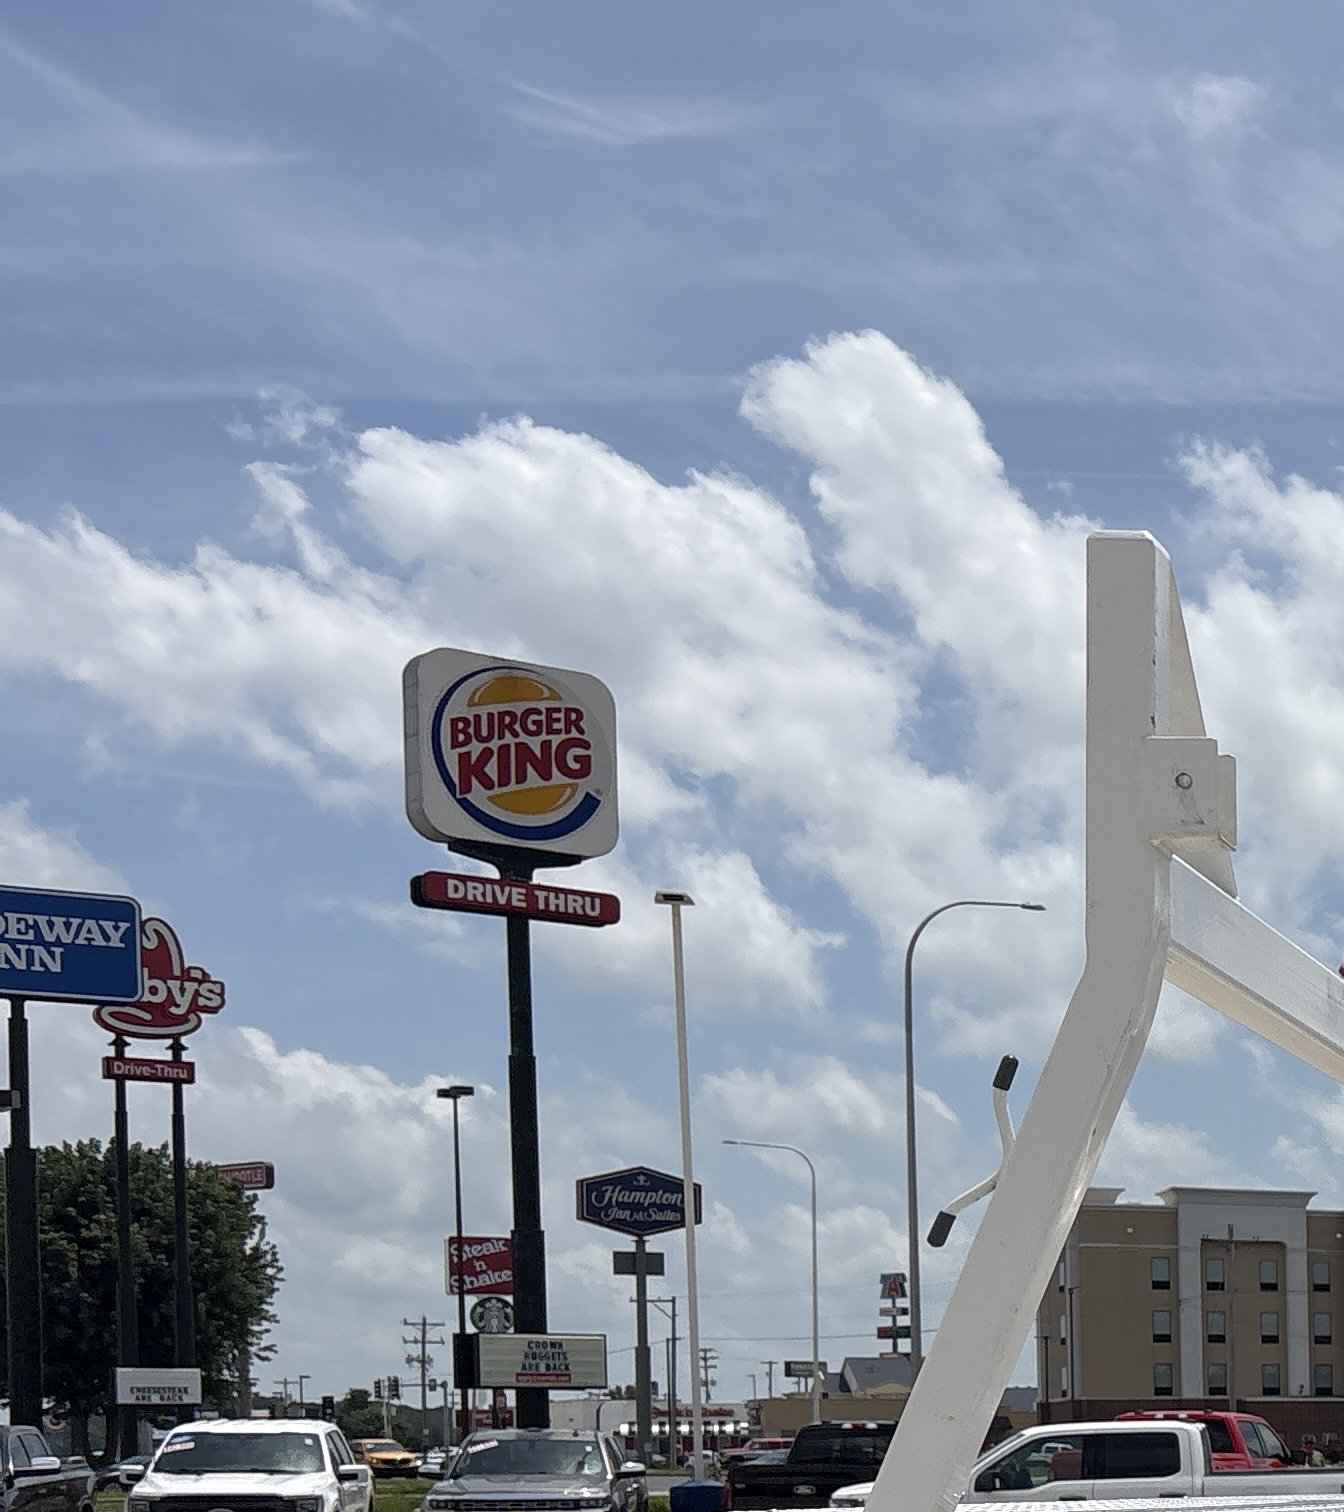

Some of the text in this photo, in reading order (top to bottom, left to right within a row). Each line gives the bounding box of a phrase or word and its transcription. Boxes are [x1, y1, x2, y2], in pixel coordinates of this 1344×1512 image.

[450, 706, 586, 749] BURGER
[457, 737, 592, 796] KING
[446, 879, 601, 916] DRIVE THRU
[0, 912, 130, 948] EWAY
[0, 943, 64, 973] NN
[142, 967, 224, 1015] by's
[113, 1061, 188, 1079] Drive-Thru
[591, 1184, 683, 1207] Hampton
[601, 1207, 634, 1221] Inn
[450, 1238, 509, 1263] Steak
[450, 1269, 512, 1293] Shake
